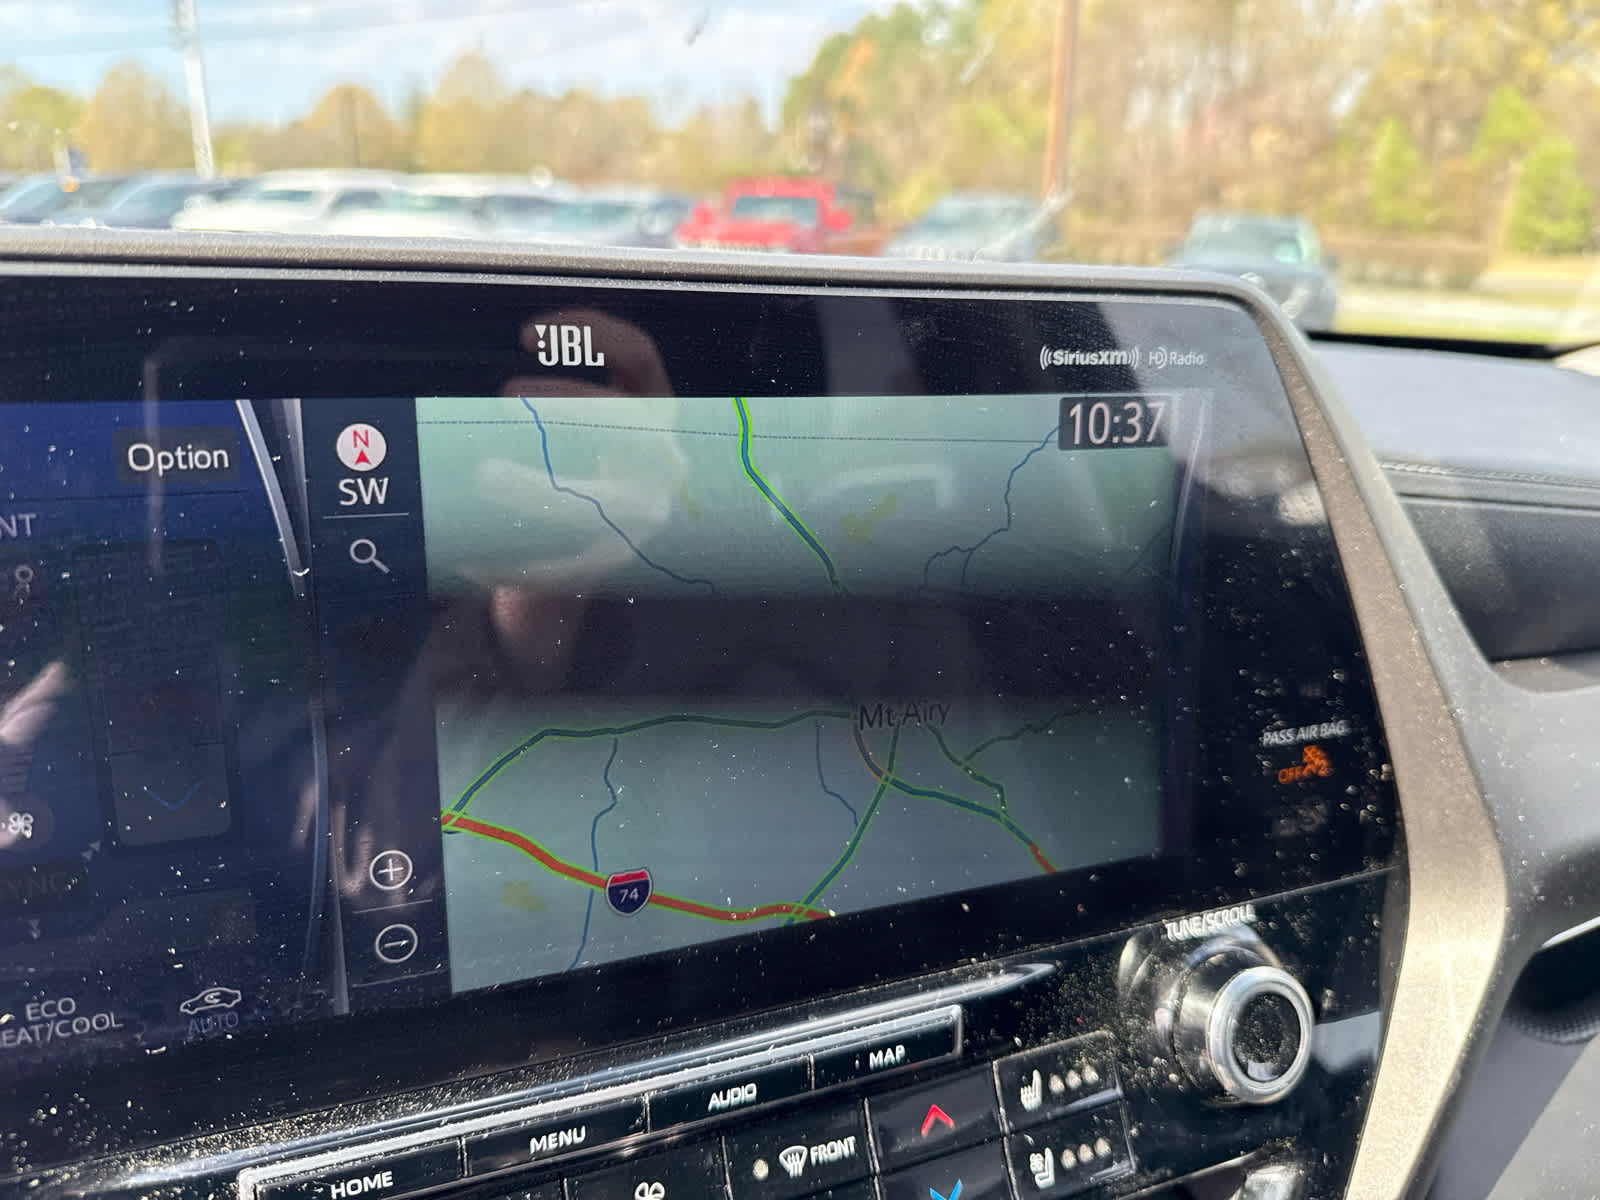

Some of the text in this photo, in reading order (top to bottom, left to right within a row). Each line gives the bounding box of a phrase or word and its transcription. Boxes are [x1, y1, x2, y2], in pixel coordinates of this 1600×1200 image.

[535, 324, 605, 367] JBL
[1169, 351, 1204, 366] Radio
[1069, 401, 1166, 445] 10:37
[352, 429, 370, 448] N
[127, 442, 230, 477] Option
[338, 477, 389, 506] SW
[902, 700, 952, 727] Airy
[1262, 720, 1348, 747] PASS AIR BAG
[620, 888, 639, 904] 74
[1165, 903, 1257, 942] TUNE/SCROLL
[25, 997, 76, 1021] ECO
[187, 1010, 239, 1036] AUTO
[1, 1012, 124, 1048] EAT/COOL
[869, 1044, 905, 1070] MAP
[707, 1082, 757, 1112] AUDIO
[529, 1125, 586, 1154] MENU
[809, 1136, 857, 1165] FRONT
[330, 1170, 393, 1199] HOME
